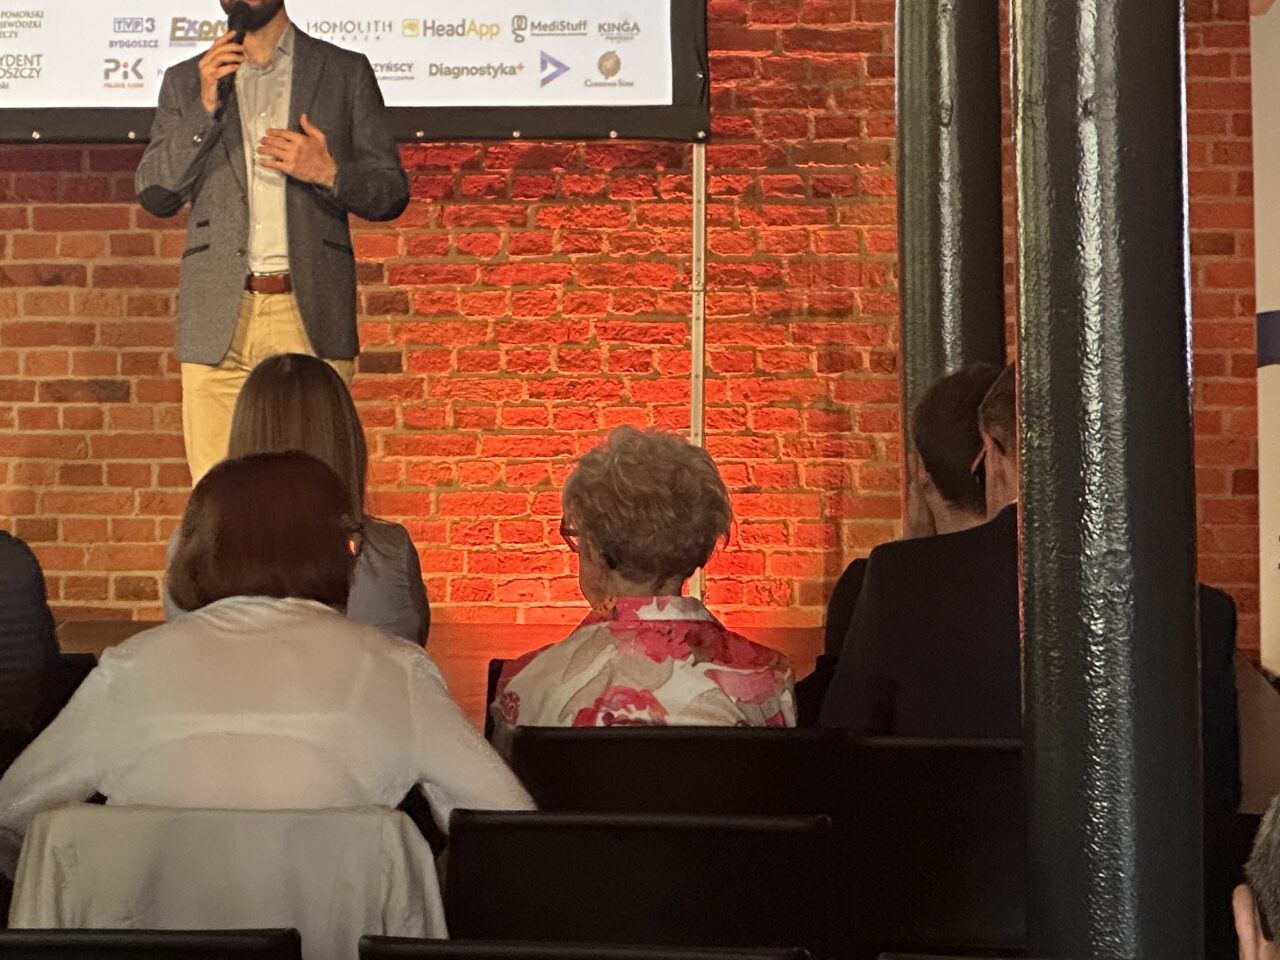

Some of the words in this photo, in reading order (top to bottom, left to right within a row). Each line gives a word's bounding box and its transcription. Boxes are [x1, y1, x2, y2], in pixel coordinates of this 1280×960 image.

[423, 18, 501, 40] HeadApp
[530, 20, 588, 32] MediStuff
[373, 61, 414, 72] ZYŃSCY
